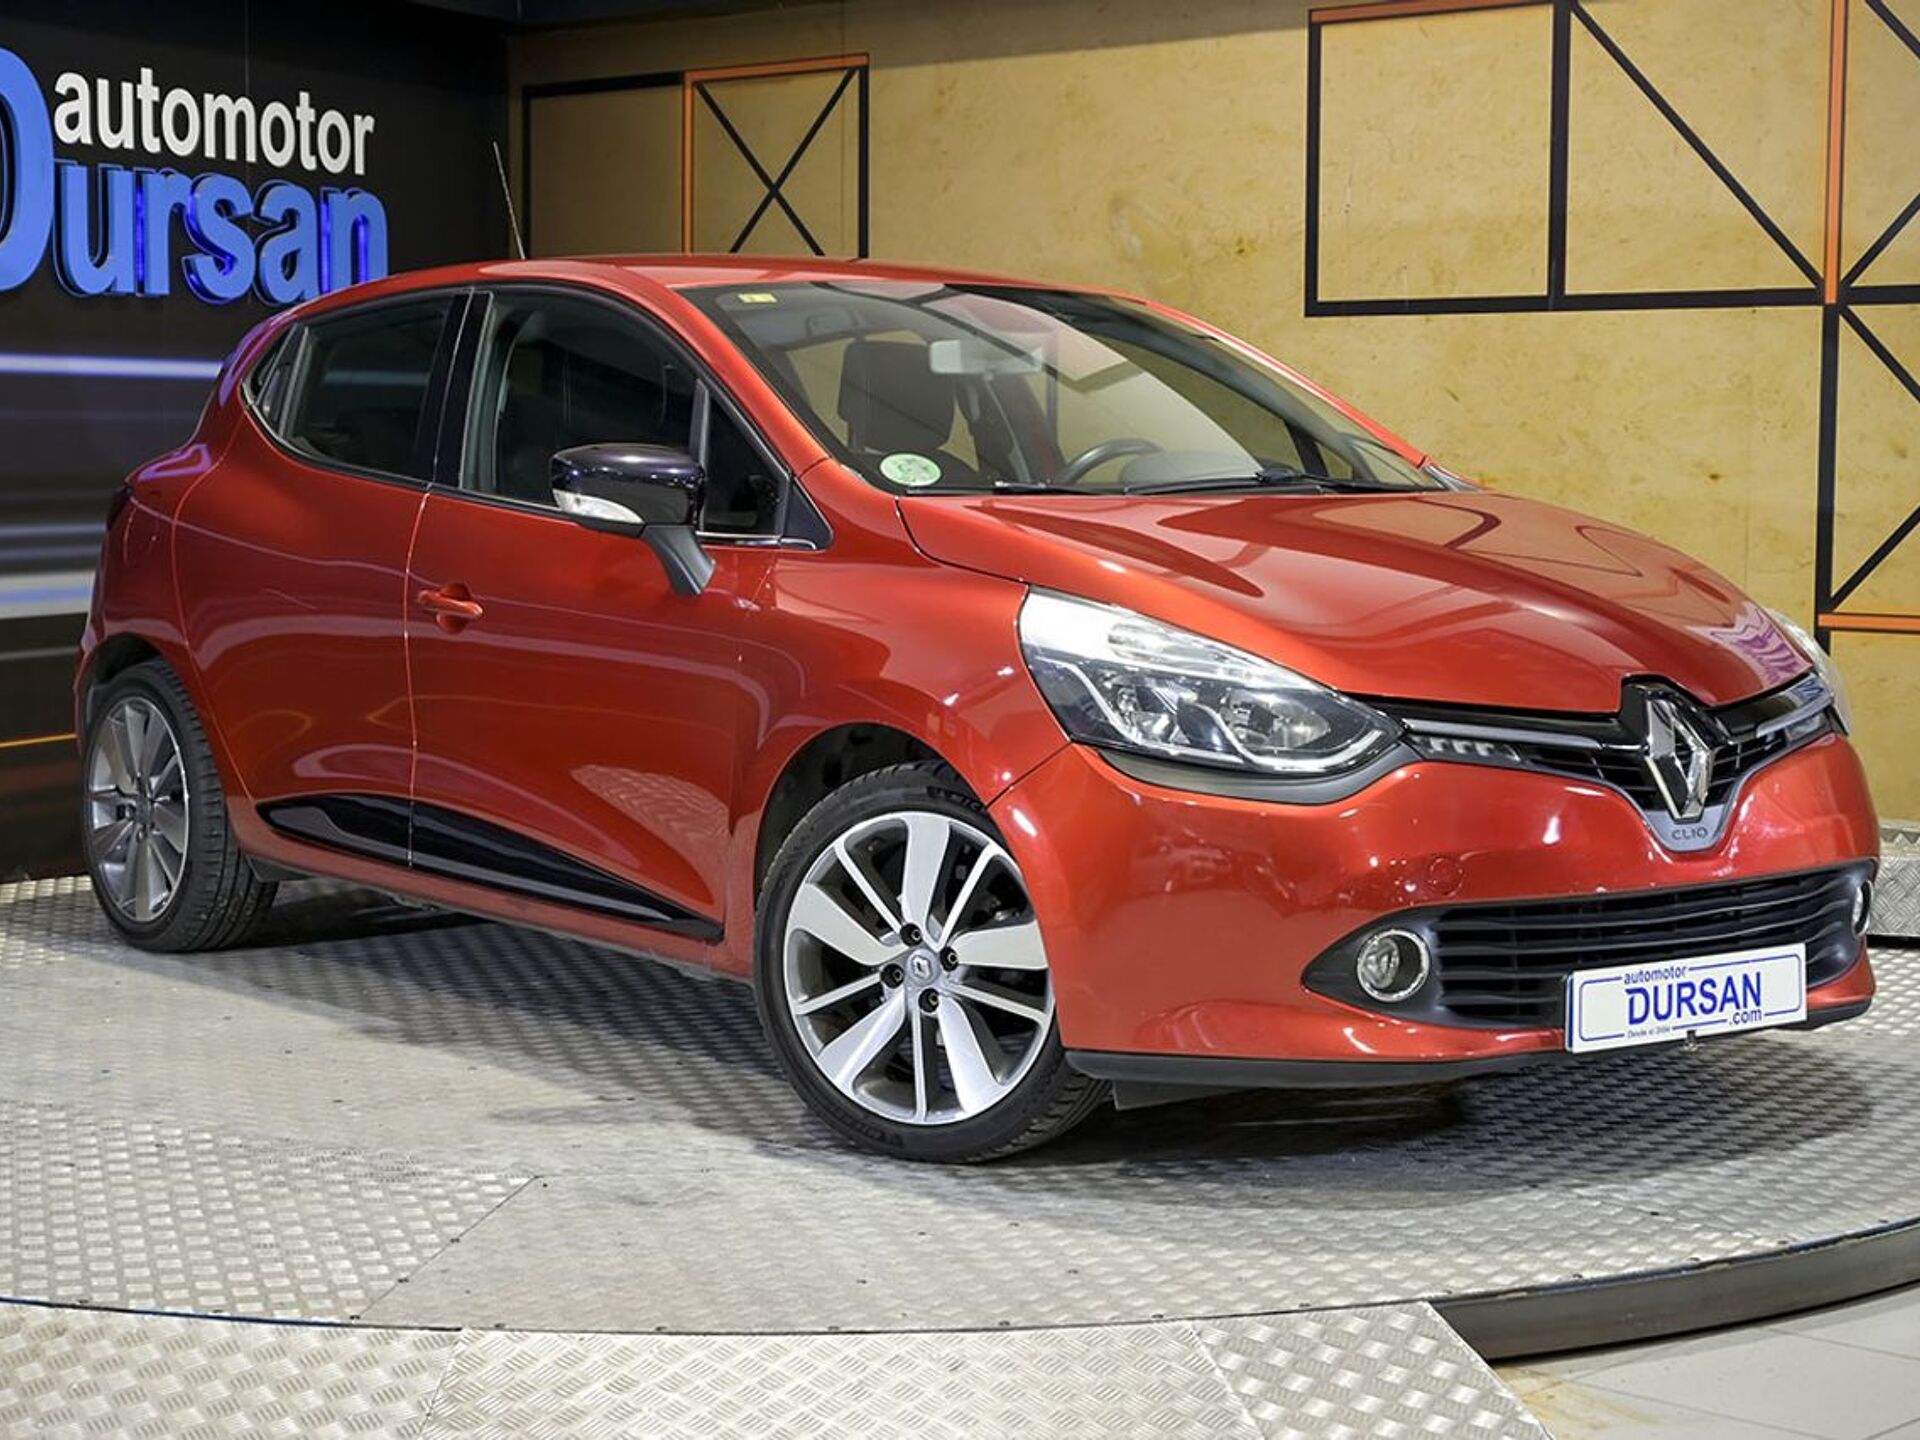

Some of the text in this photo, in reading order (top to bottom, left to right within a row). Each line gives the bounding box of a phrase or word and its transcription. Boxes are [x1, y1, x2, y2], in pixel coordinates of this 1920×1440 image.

[54, 67, 375, 175] automotor
[1671, 826, 1708, 840] CLIO
[1624, 966, 1687, 984] automotor
[1625, 972, 1761, 1025] DURSAN
[1729, 1009, 1762, 1025] .com
